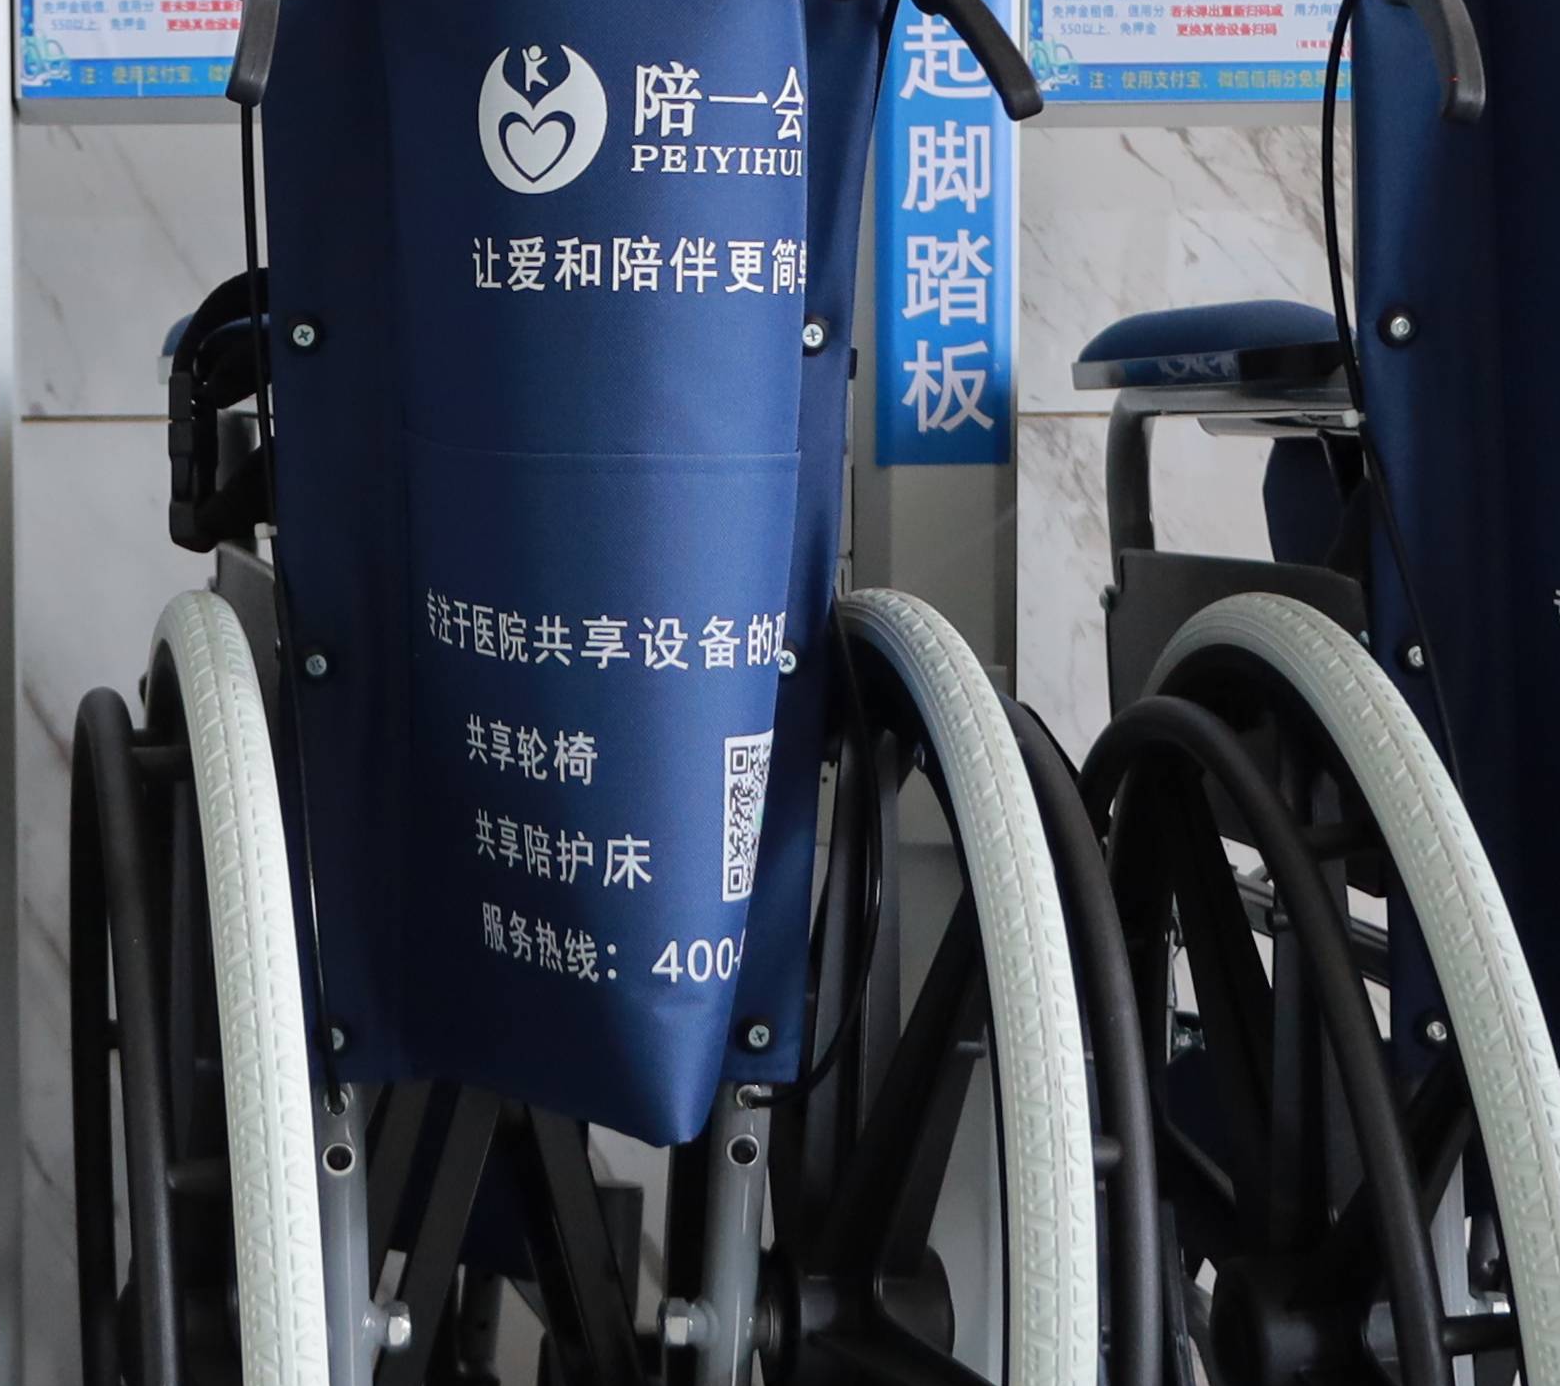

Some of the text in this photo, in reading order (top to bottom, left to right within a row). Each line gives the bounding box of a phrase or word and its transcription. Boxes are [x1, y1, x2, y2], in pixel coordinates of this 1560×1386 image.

[633, 61, 805, 142] 陪一会
[466, 713, 598, 786] 共享轮椅
[475, 808, 653, 891] 共享陪护床
[481, 901, 617, 983] 服务热线：
